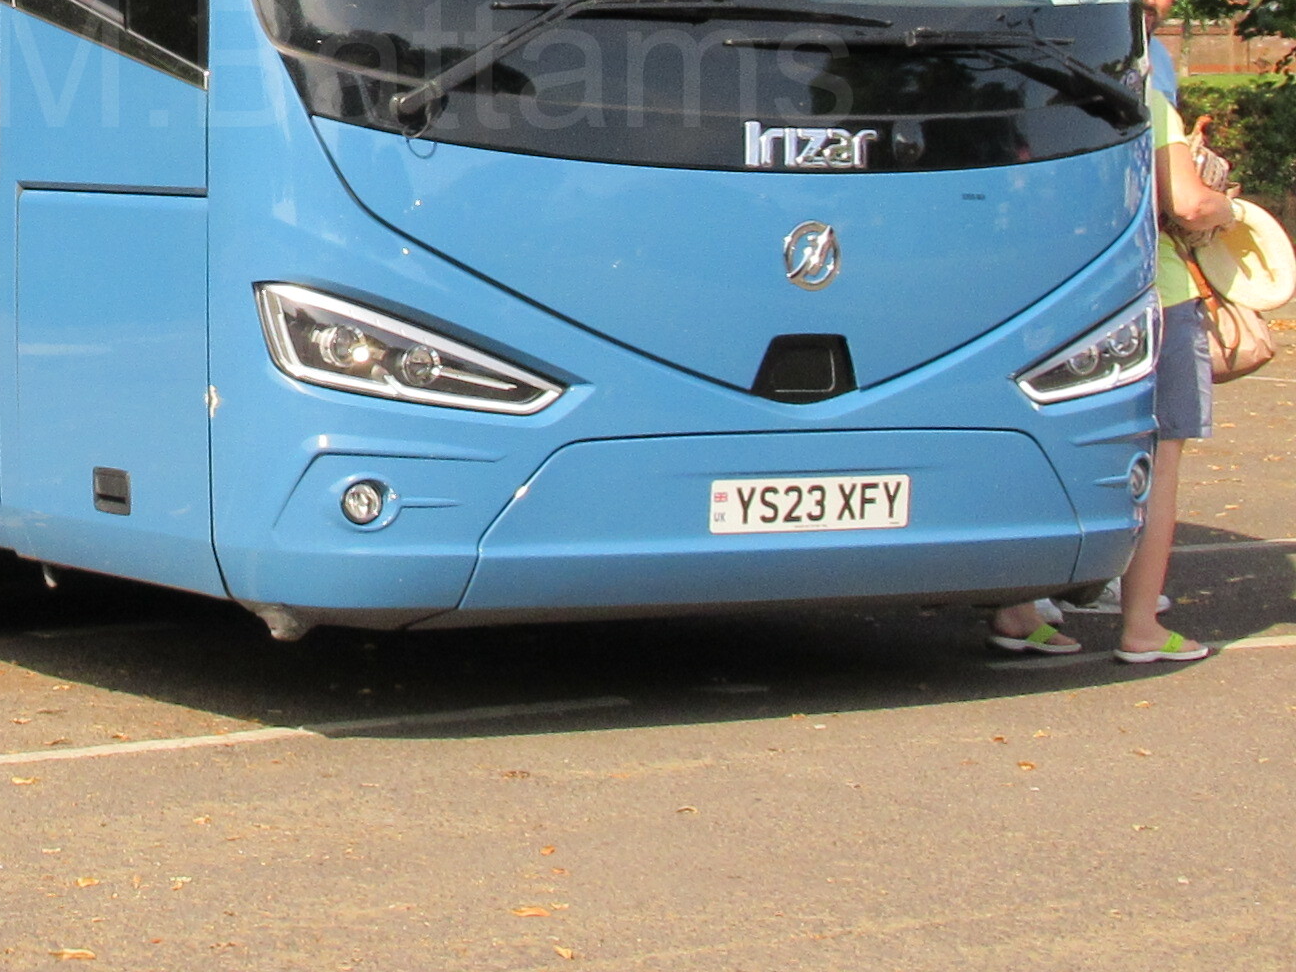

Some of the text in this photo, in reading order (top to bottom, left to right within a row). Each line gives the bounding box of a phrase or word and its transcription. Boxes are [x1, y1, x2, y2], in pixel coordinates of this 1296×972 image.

[745, 120, 879, 169] Irizar
[713, 512, 727, 523] UK
[736, 481, 903, 525] YS23 XFY
